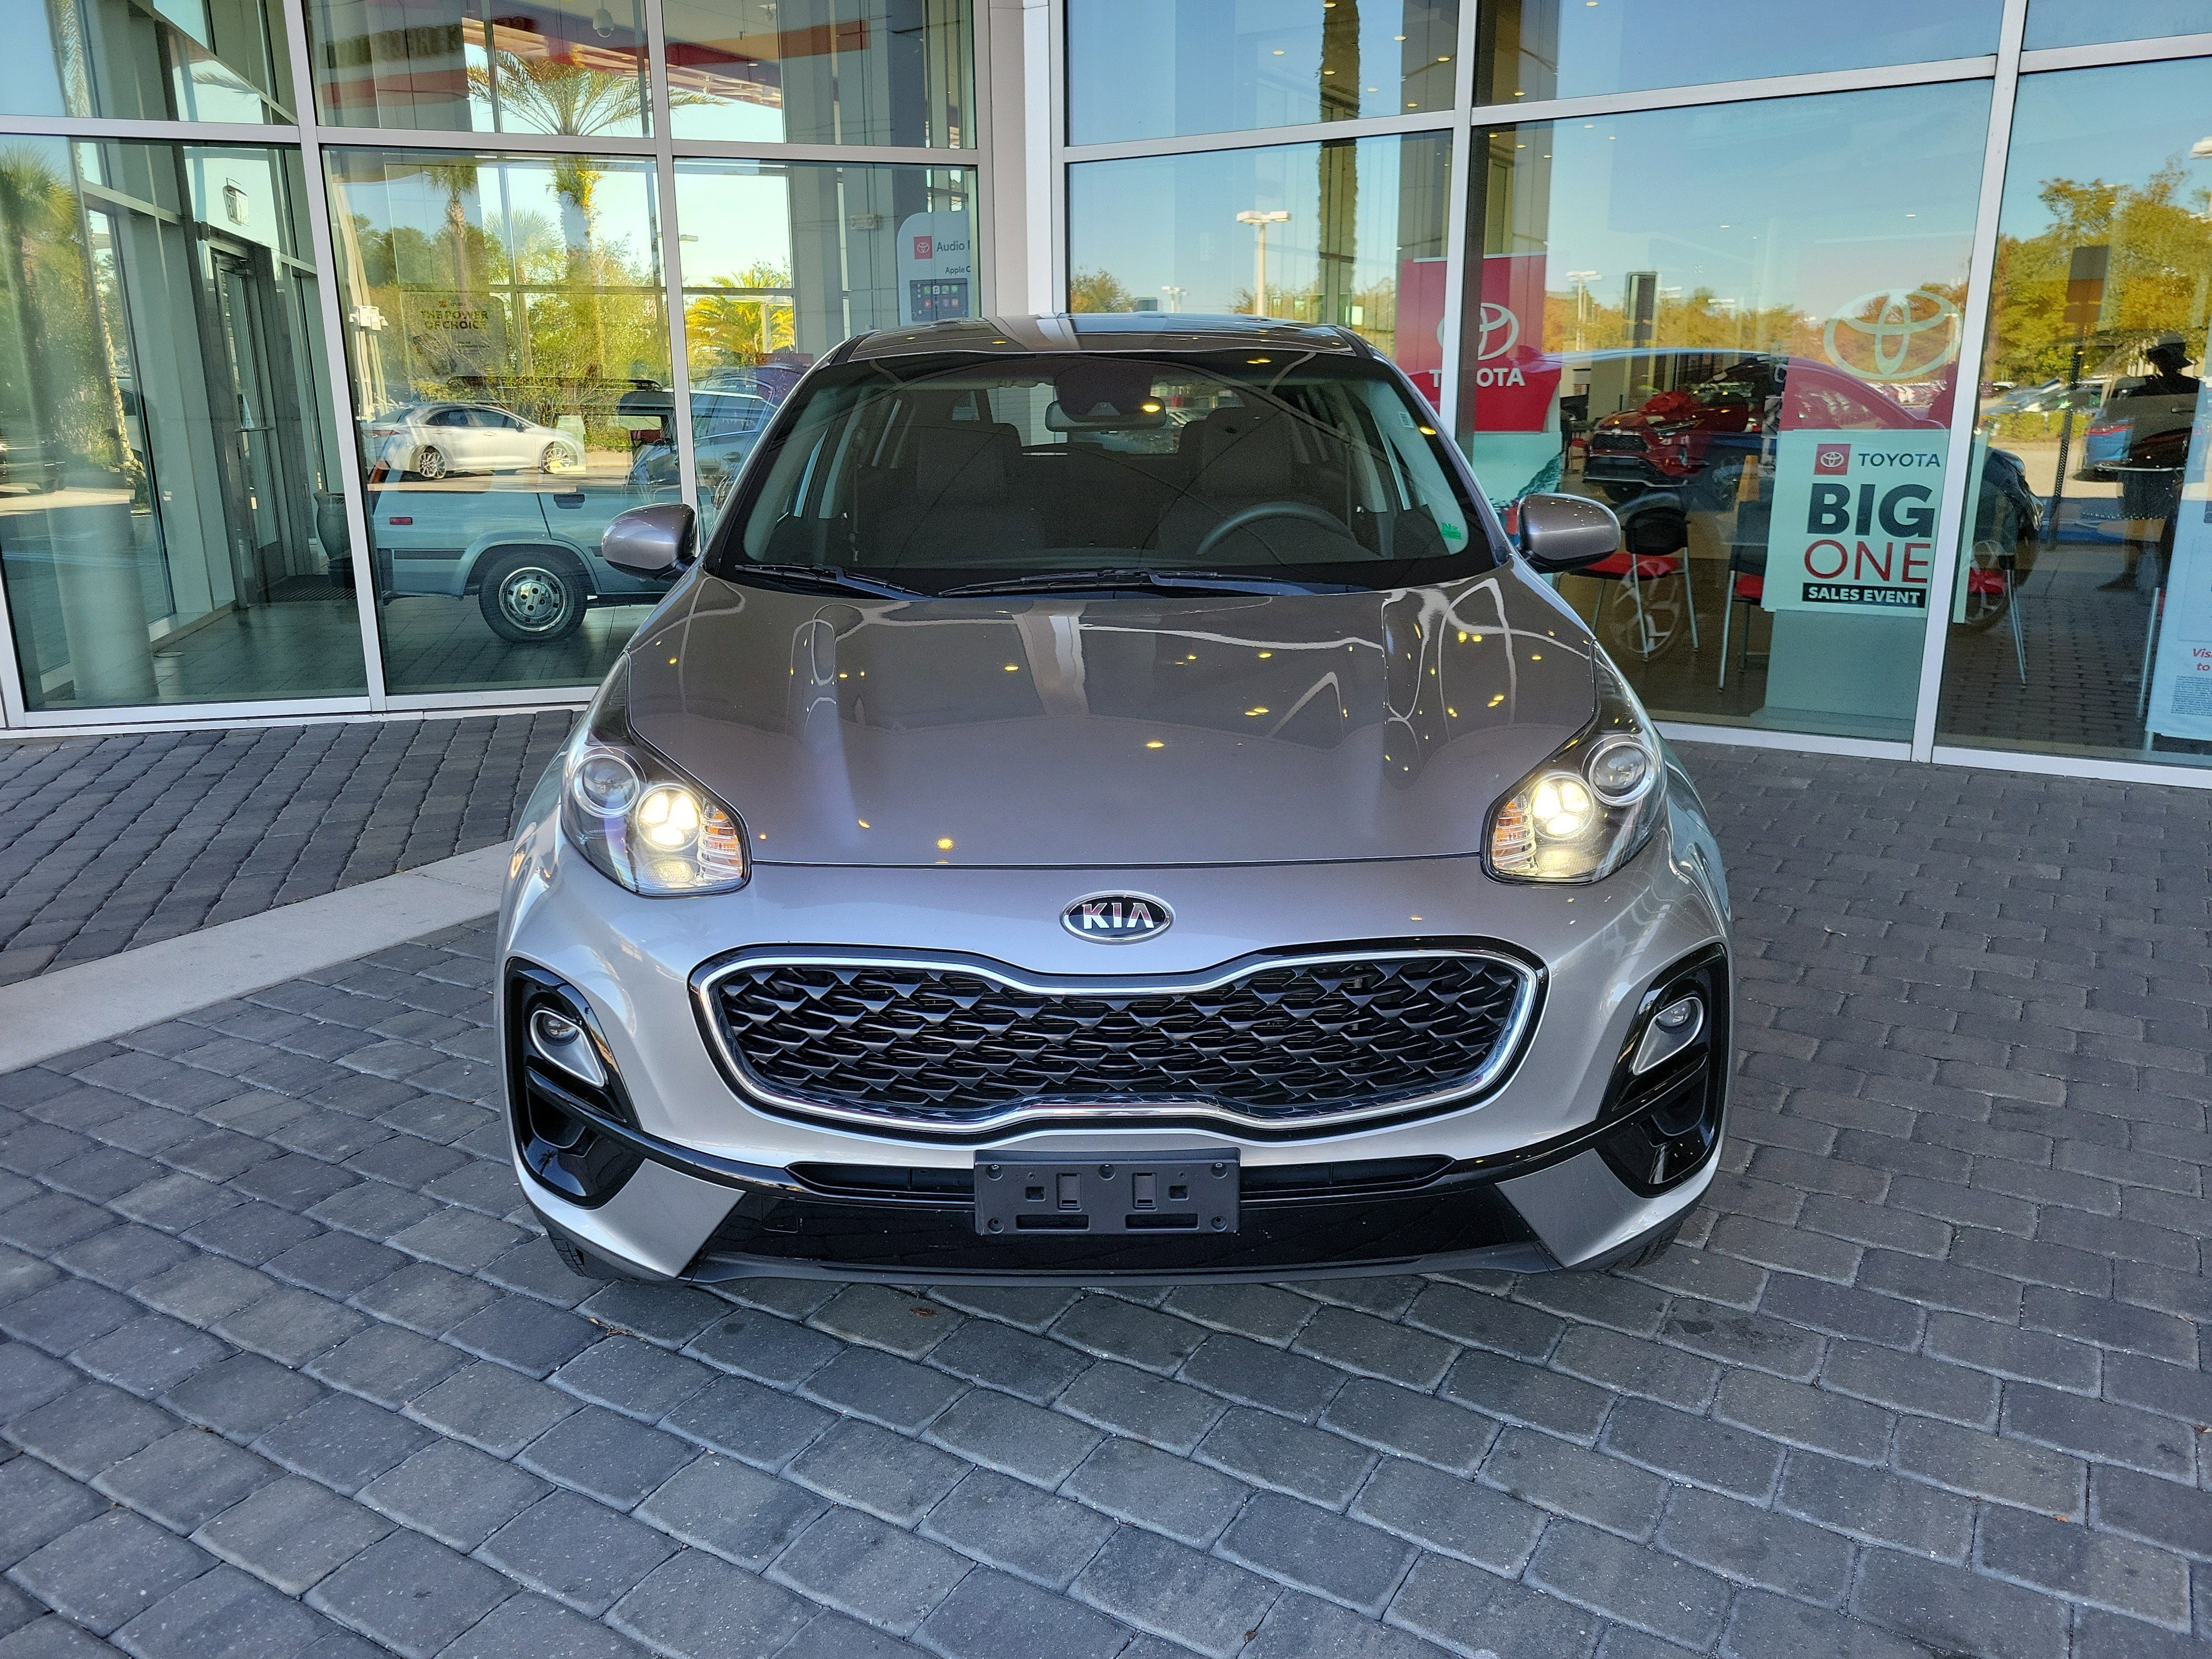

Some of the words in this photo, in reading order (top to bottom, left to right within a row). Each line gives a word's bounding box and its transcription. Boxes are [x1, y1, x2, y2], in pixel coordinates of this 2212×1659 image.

[936, 241, 965, 252] Audio
[945, 266, 965, 275] Apple
[445, 311, 488, 319] POWER
[424, 321, 439, 329] OF
[442, 320, 487, 330] CHOICE
[1429, 368, 1526, 387] TOTA
[1858, 453, 1941, 467] TOYOTA
[1807, 483, 1935, 538] BIG
[1804, 539, 1931, 584] ONE
[1808, 586, 1860, 601] SALES
[1863, 589, 1921, 604] EVENT
[2193, 648, 2212, 658] Vis
[2197, 663, 2210, 671] to
[1082, 902, 1155, 929] KIA
